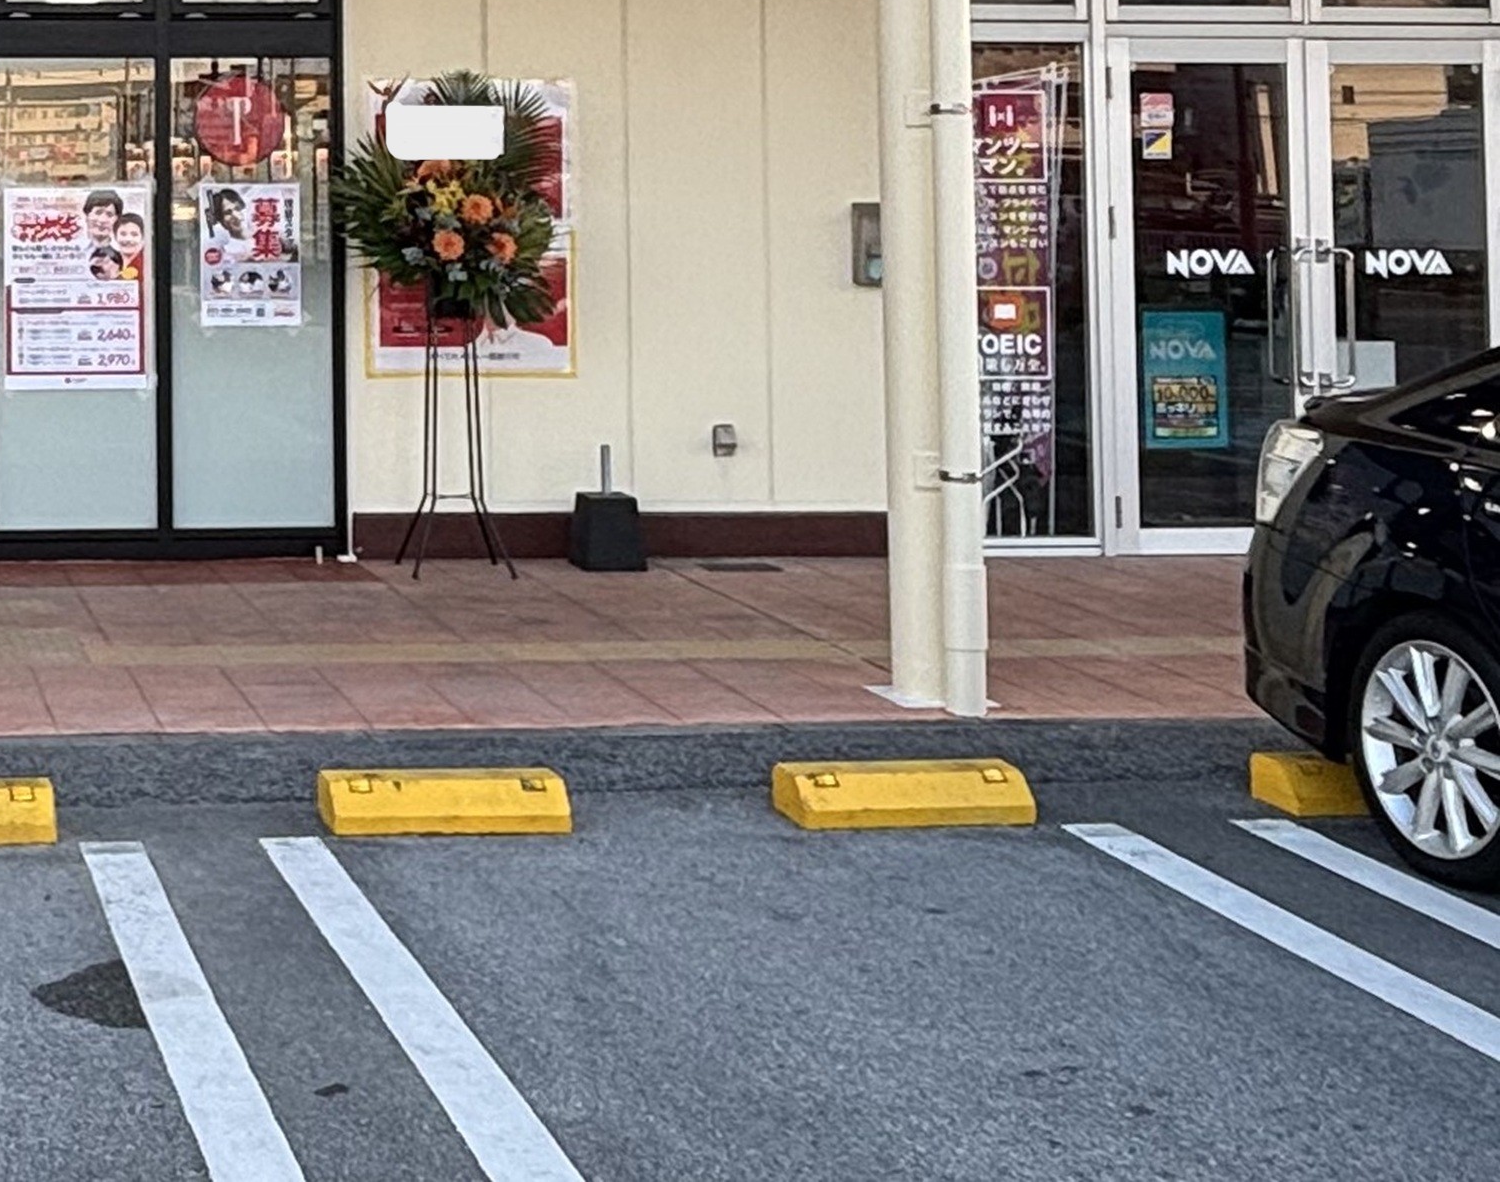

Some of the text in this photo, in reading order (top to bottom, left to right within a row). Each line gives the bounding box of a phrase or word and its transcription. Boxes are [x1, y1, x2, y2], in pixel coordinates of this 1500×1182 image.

[251, 197, 280, 258] 募集
[1166, 249, 1254, 278] NOVA
[1365, 249, 1452, 278] NOVA
[1149, 339, 1217, 360] NOVA
